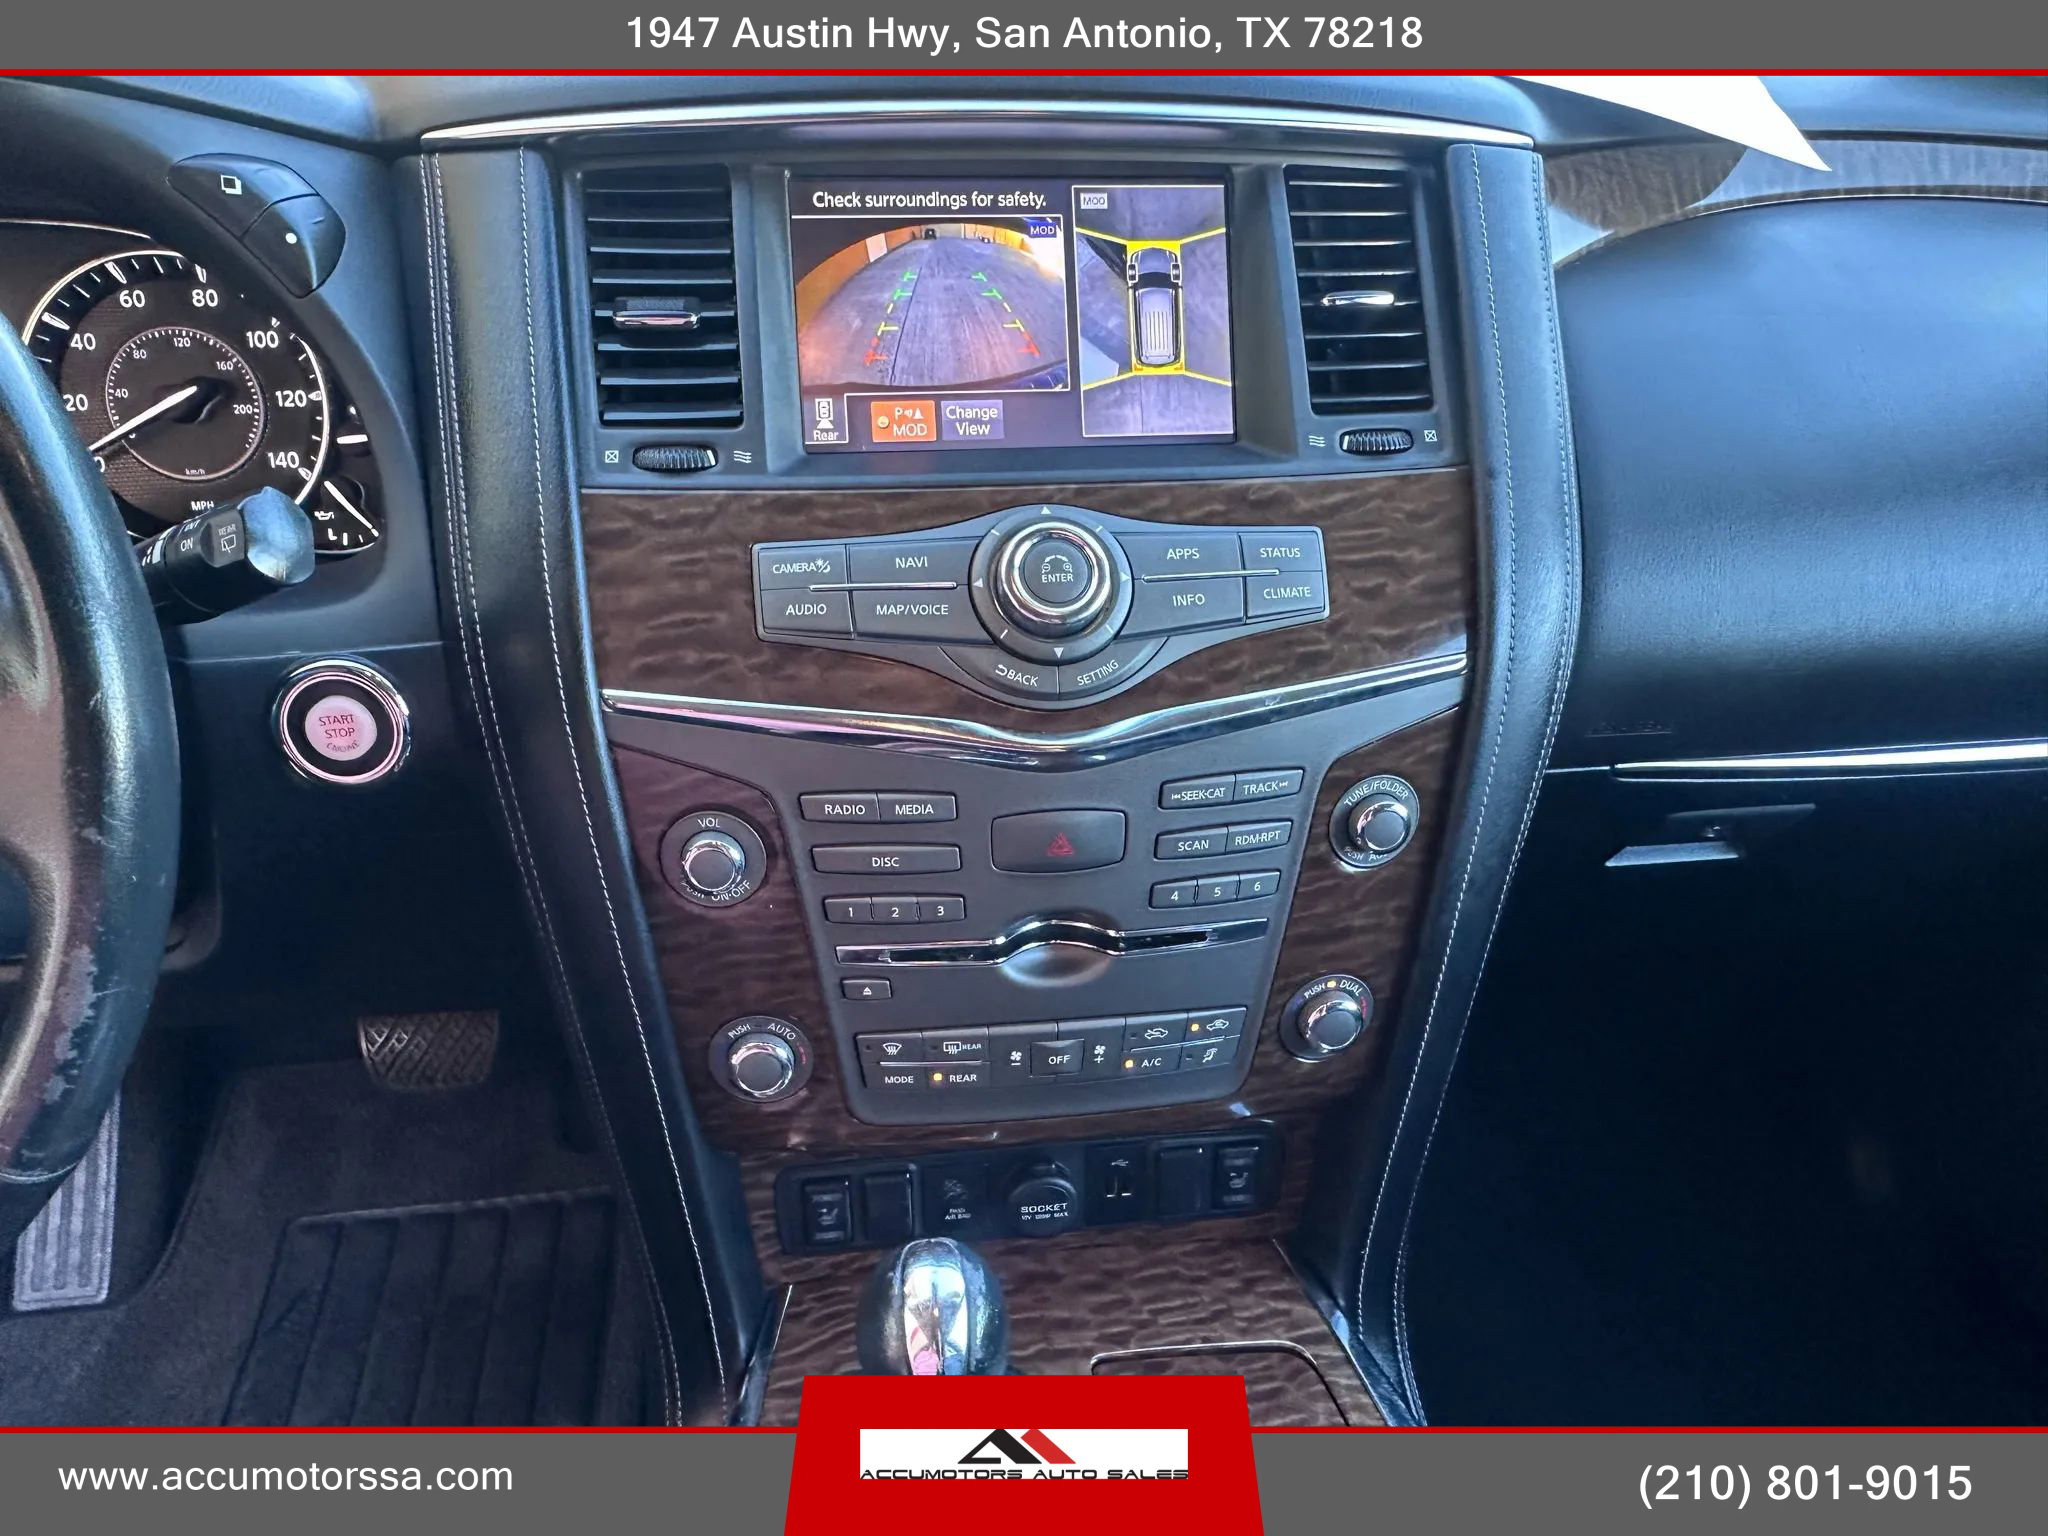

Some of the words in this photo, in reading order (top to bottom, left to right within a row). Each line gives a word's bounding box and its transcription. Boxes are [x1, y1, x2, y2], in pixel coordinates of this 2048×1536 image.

[812, 191, 861, 207] Check
[865, 191, 967, 209] surroundings
[971, 190, 994, 206] for
[997, 190, 1047, 209] safety.
[1083, 196, 1106, 206] MOD
[1030, 225, 1055, 235] MOD
[119, 290, 145, 308] 60
[192, 289, 218, 307] 80
[70, 333, 96, 350] 40
[173, 337, 190, 347] 120
[246, 331, 279, 348] 100
[133, 349, 147, 359] 80
[216, 361, 234, 371] 160
[115, 388, 128, 398] 40
[63, 394, 88, 411] 20
[276, 391, 307, 408] 120
[233, 404, 253, 415] 200
[946, 405, 998, 421] Change
[813, 428, 839, 441] Rear
[893, 423, 928, 437] MOD
[956, 421, 990, 436] View
[268, 452, 299, 469] 140
[191, 501, 214, 511] MPH
[181, 537, 193, 551] ON
[1166, 547, 1200, 562] APPS
[1259, 546, 1301, 561] STATUS
[772, 561, 816, 575] CAMERA
[896, 555, 929, 570] NAVI
[1041, 572, 1074, 584] ENTER
[1263, 585, 1312, 601] CLIMATE
[1172, 592, 1206, 607] INFO
[785, 602, 827, 617] AUDIO
[876, 602, 949, 618] MAP/VOICE
[1006, 669, 1039, 688] BACK
[1076, 658, 1120, 687] SETTING
[319, 714, 354, 726] START
[325, 728, 355, 739] STOP
[1243, 780, 1278, 795] TRACK
[1344, 780, 1409, 806] TUNE/FOLDER
[825, 804, 866, 816] RADIO
[895, 804, 934, 816] MEDIA
[697, 818, 720, 828] VOL
[1178, 840, 1209, 852] SCAN
[872, 857, 900, 868] DISC
[1214, 887, 1221, 897] 5
[1254, 881, 1261, 891] 6
[1170, 891, 1179, 901] 4
[848, 907, 854, 917] 1
[891, 907, 899, 918] 2
[937, 906, 944, 916] 3
[1304, 983, 1326, 999] PUSH
[1339, 979, 1363, 997] DUAL
[728, 1023, 751, 1040] PUSH
[767, 1023, 796, 1041] AUTO
[962, 1043, 982, 1051] REAR
[1048, 1055, 1070, 1065] OFF
[1141, 1057, 1162, 1068] A/C
[885, 1075, 914, 1084] MODE
[950, 1074, 977, 1083] REAR
[1021, 1203, 1068, 1213] SOCKET
